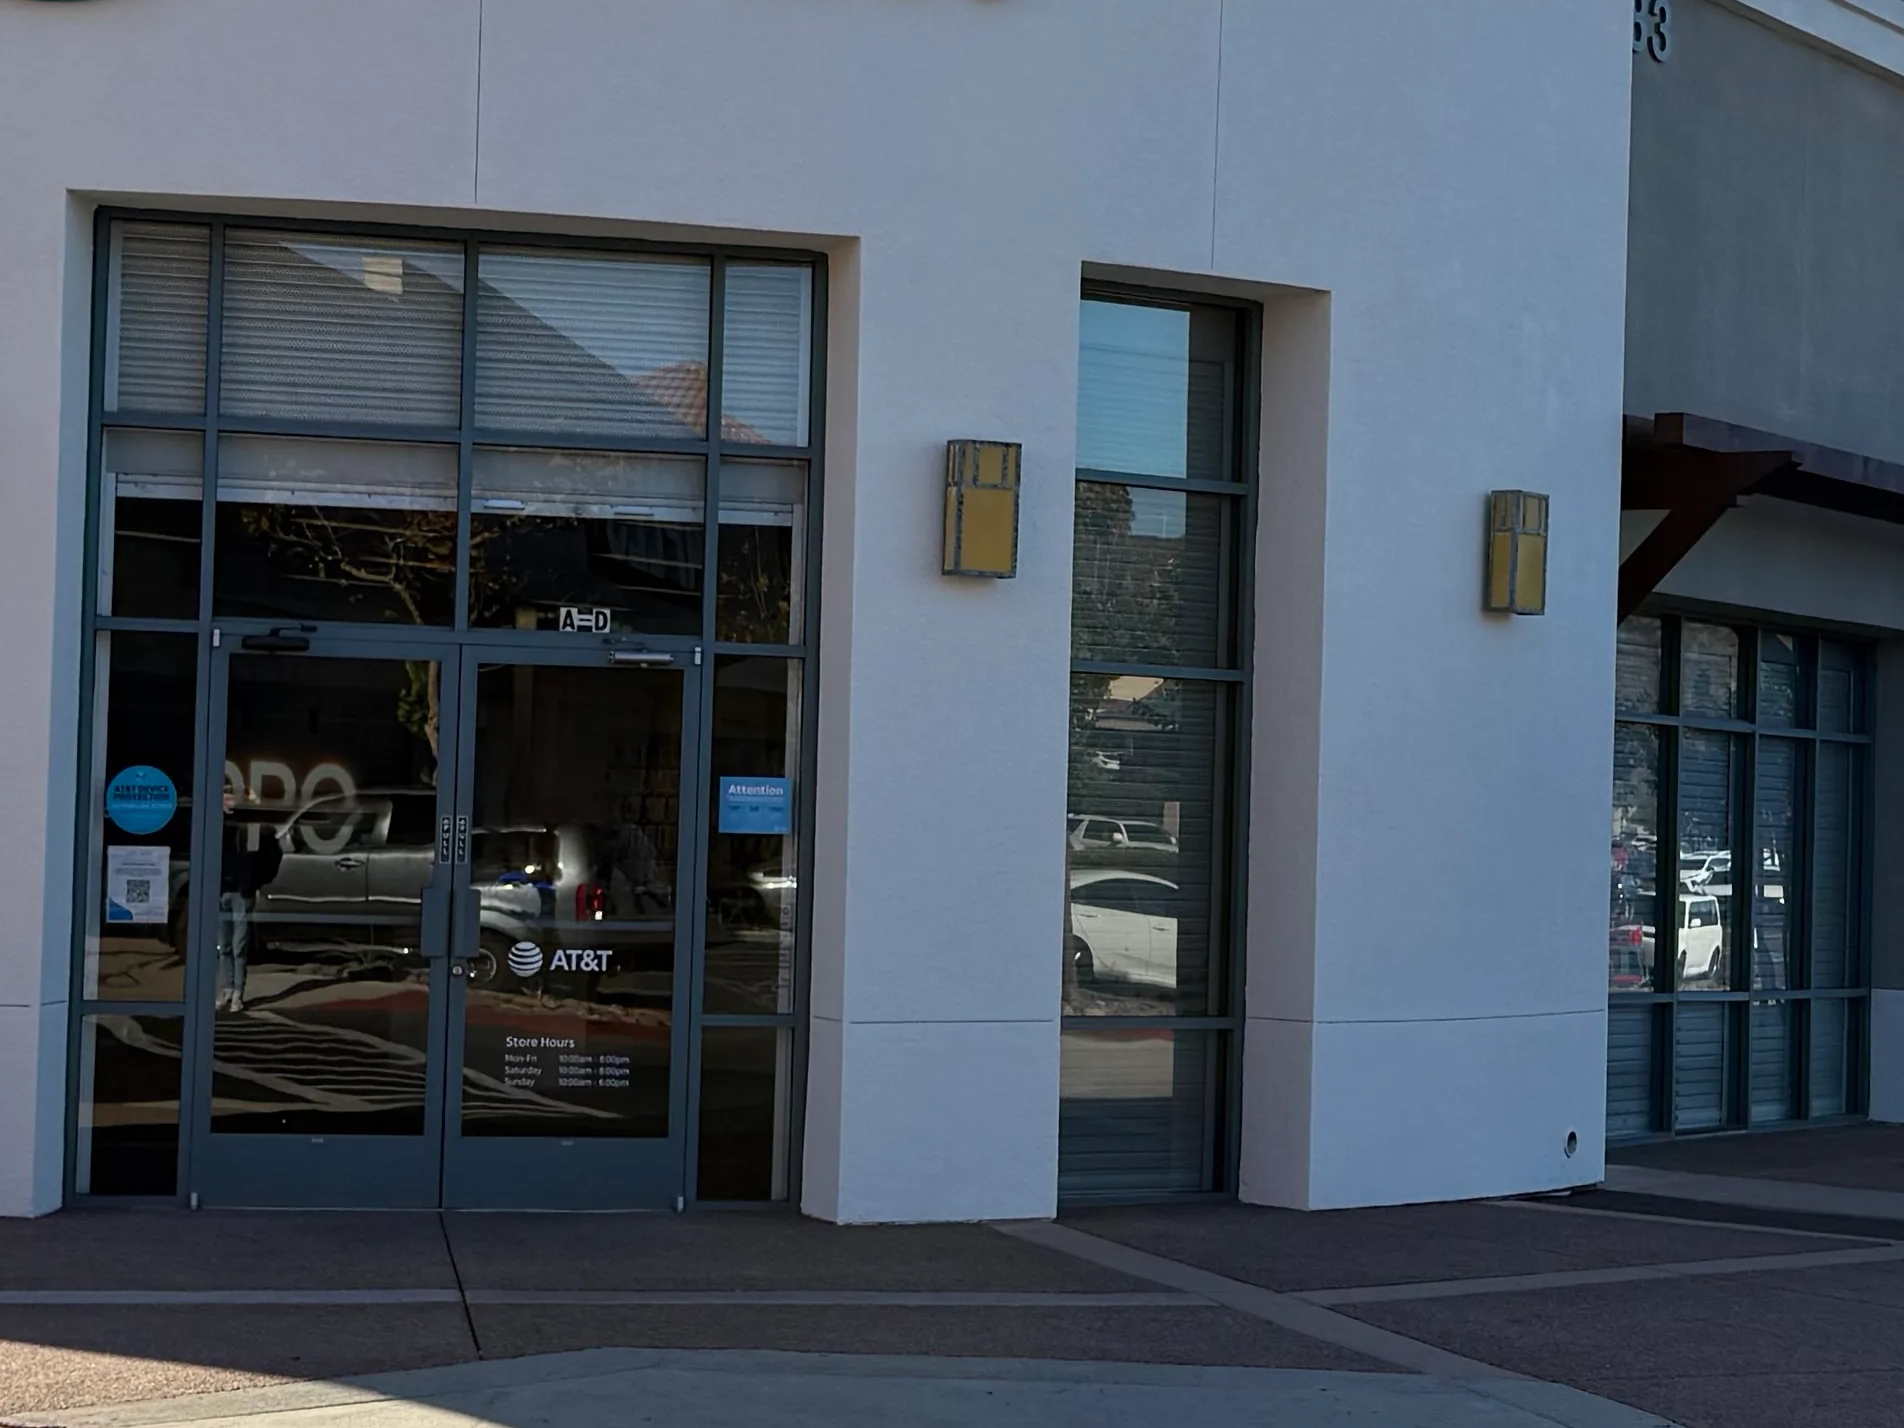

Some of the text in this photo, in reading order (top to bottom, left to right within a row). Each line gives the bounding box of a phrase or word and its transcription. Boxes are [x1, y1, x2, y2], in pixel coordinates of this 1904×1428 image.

[728, 784, 784, 796] Attention
[549, 948, 614, 972] AT&T
[505, 1036, 576, 1048] Store Hours
[504, 1065, 543, 1076] Saturday
[504, 1077, 536, 1088] Sunday
